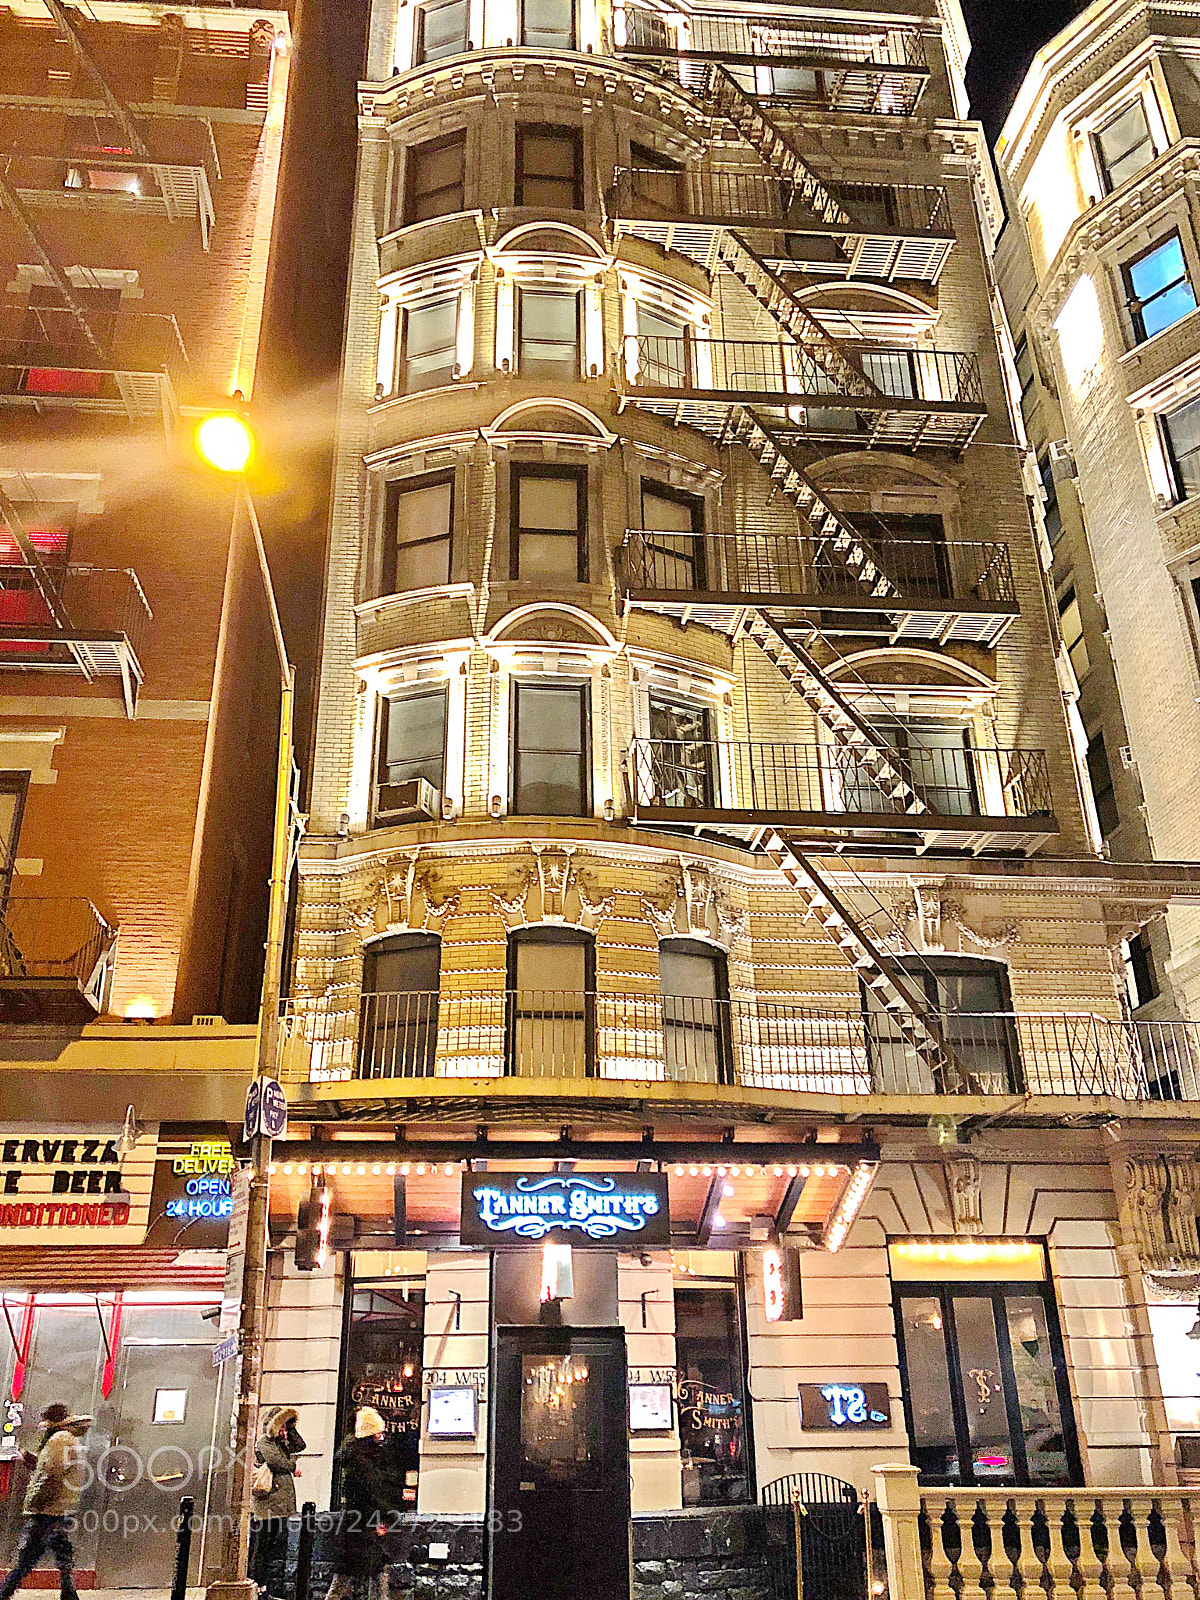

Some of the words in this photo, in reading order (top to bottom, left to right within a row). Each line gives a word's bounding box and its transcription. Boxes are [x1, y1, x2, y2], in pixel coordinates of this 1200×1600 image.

[190, 1144, 232, 1157] FREE
[52, 1171, 121, 1193] BEER
[186, 1180, 230, 1195] OPEN
[166, 1200, 186, 1216] 24
[474, 1188, 565, 1220] TANNER
[569, 1190, 659, 1220] SMITH'S
[0, 1203, 130, 1226] NDITIONED
[424, 1370, 447, 1384] 204
